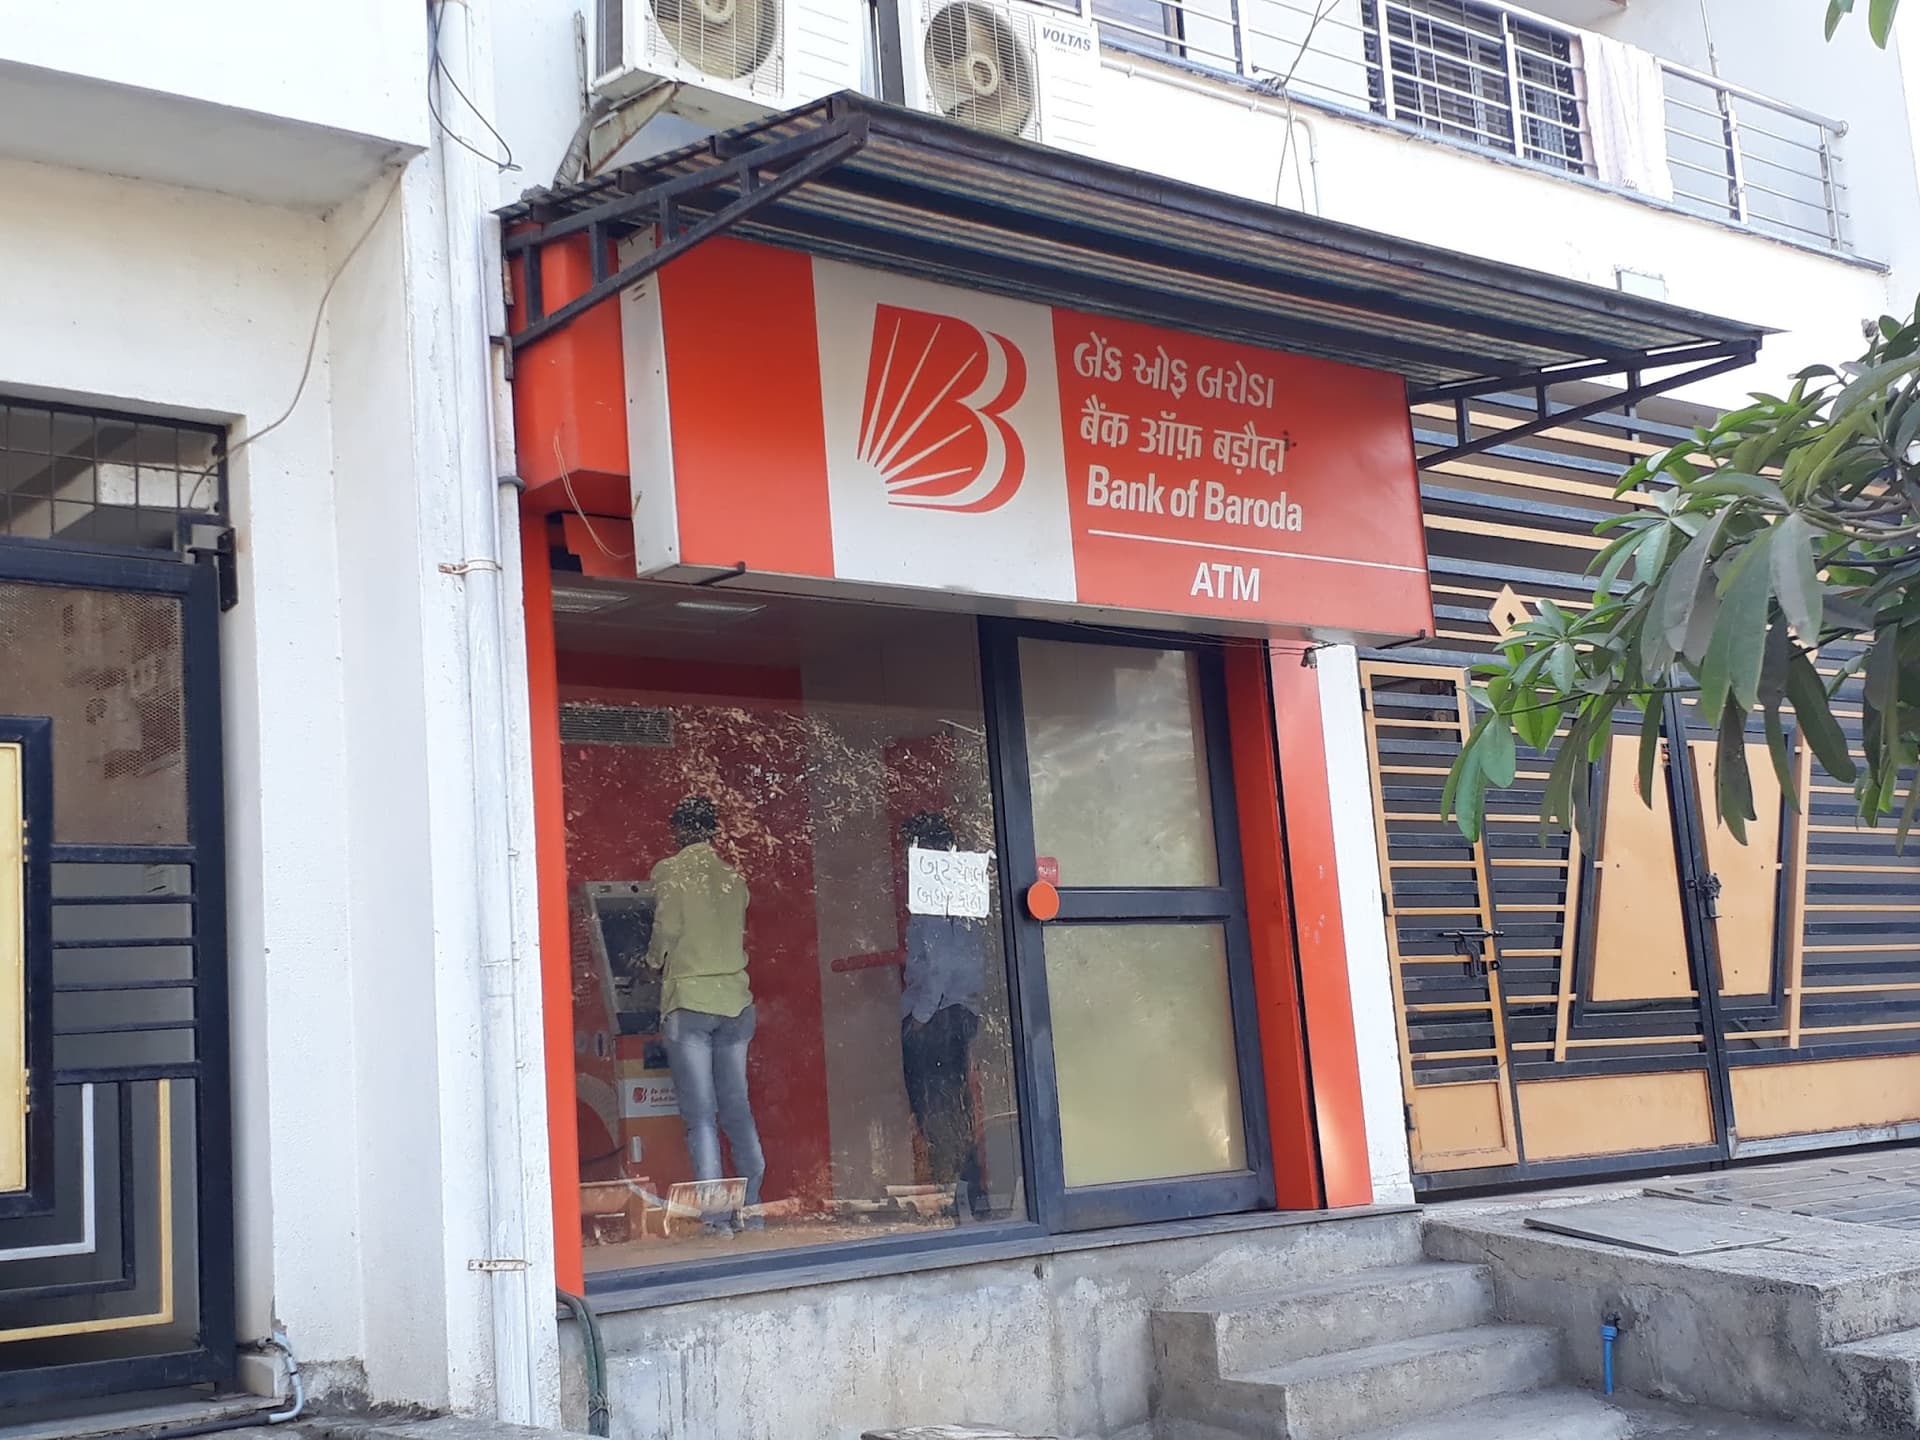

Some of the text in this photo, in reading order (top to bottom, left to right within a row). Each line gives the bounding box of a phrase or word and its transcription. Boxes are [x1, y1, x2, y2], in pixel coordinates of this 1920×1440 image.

[1043, 26, 1092, 52] VOLTAS
[1073, 331, 1123, 382] બેંક
[1196, 360, 1275, 409] બરોડા
[1080, 394, 1131, 448] बैंक
[1212, 420, 1287, 476] बड़ौदा
[1086, 463, 1303, 533] Bank of Baroda
[1190, 561, 1261, 602] ATM
